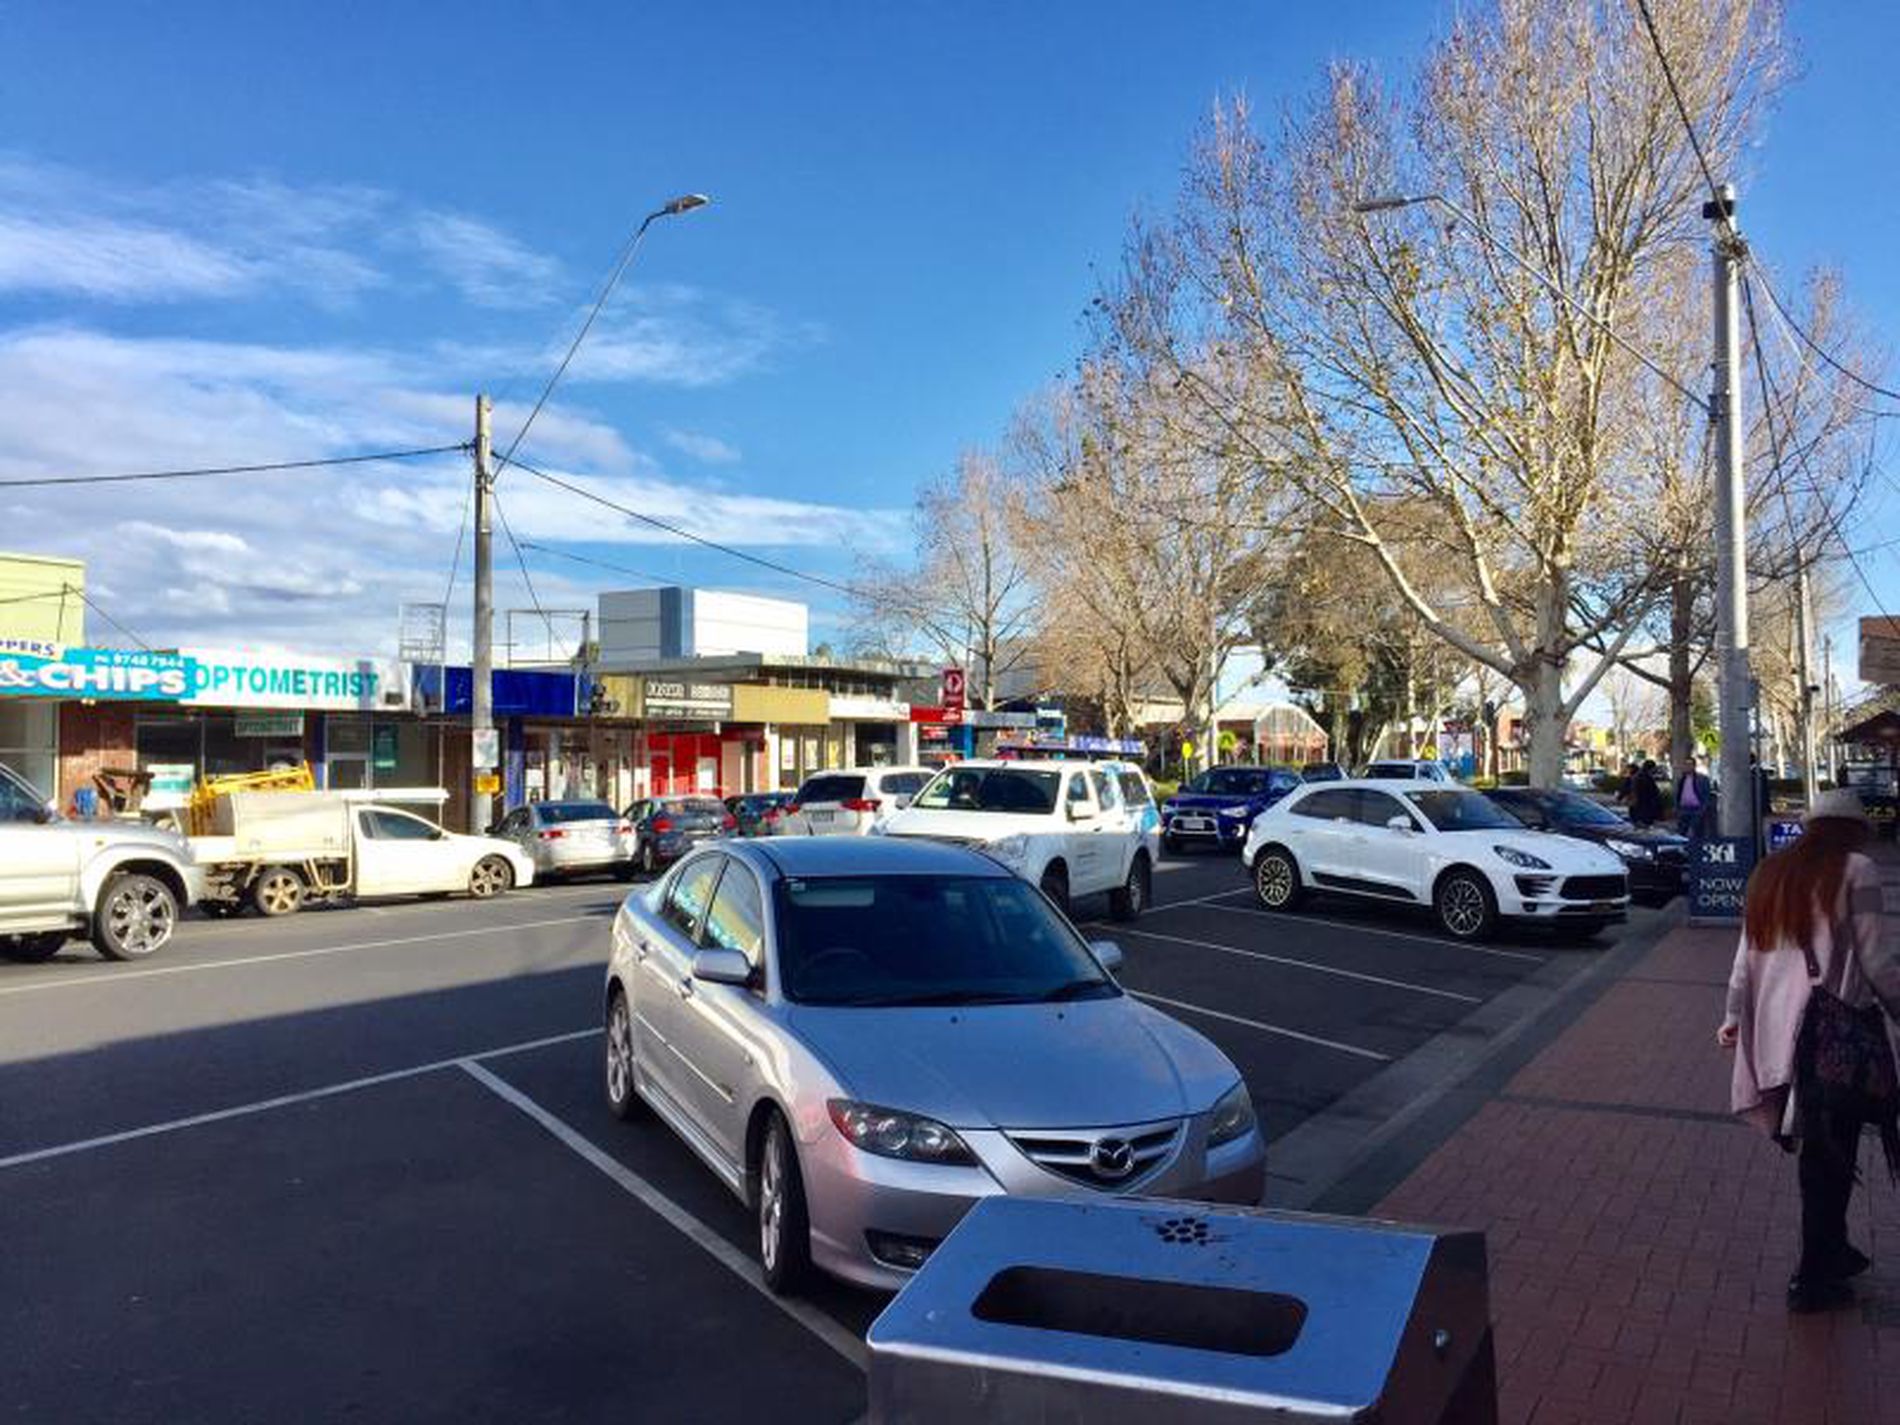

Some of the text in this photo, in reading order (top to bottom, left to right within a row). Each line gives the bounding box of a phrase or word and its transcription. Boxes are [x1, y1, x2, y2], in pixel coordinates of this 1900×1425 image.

[0, 660, 186, 694] & CHIPS
[195, 664, 379, 697] OPTOMETRIST
[1700, 878, 1744, 891] NOW
[1698, 894, 1745, 907] OPEN
